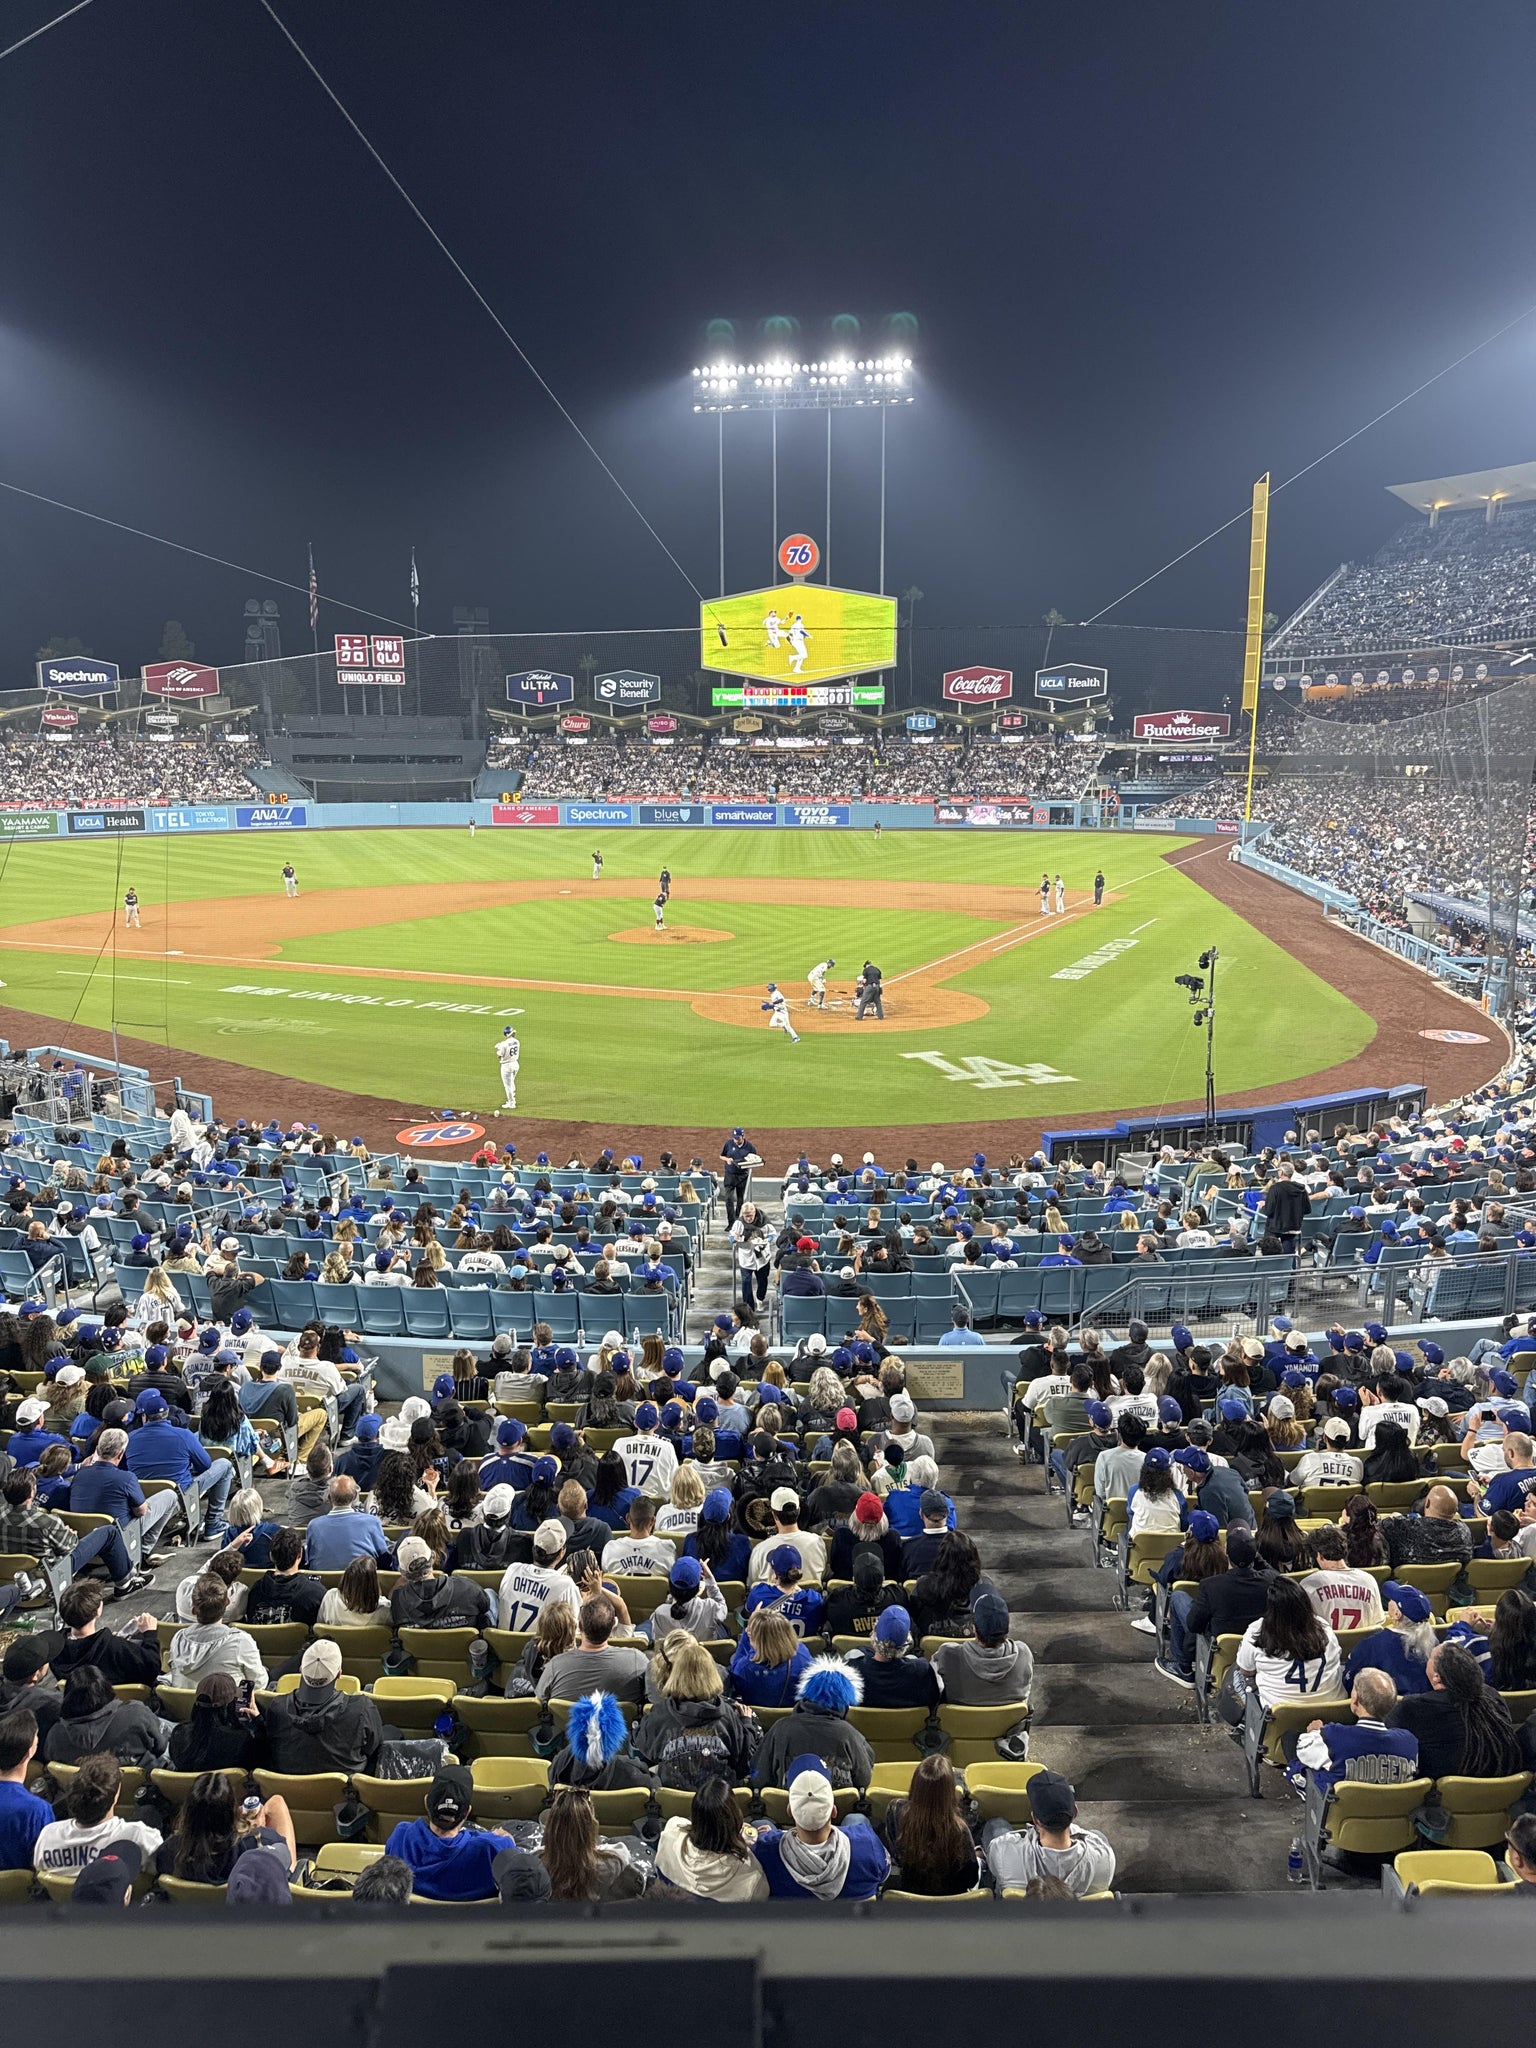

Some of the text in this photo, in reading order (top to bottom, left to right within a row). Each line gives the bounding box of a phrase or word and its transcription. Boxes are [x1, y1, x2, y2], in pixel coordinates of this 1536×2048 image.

[787, 544, 812, 565] 76
[376, 640, 398, 651] UNI
[376, 652, 400, 664] QLO
[49, 669, 107, 683] Spectrum
[341, 673, 402, 683] UNIQLO FIELD
[521, 681, 559, 690] ULTRA
[619, 679, 654, 690] Security
[949, 675, 1005, 695] Coca-Cola
[1040, 678, 1100, 688] UCLA Health
[620, 689, 649, 698] Benefit
[45, 713, 77, 721] Yakult
[910, 718, 933, 728] TEL
[562, 719, 589, 728] Churu
[1143, 723, 1220, 737] Budweiser
[251, 809, 278, 821] ANA
[570, 808, 624, 821] Spectrum
[655, 809, 679, 819] blue
[715, 811, 773, 821] smartwater
[794, 807, 829, 816] TOYO
[1036, 813, 1046, 821] 76
[78, 816, 139, 827] UCLA Health
[155, 812, 190, 828] TEL
[799, 815, 838, 825] TIRES
[1216, 822, 1239, 832] Yakult
[288, 990, 414, 1007] UNIQLO
[414, 1001, 525, 1016] FIELD
[897, 1050, 1082, 1089] LA
[407, 1122, 475, 1144] 76
[224, 1339, 249, 1350] OHTANI
[1284, 1363, 1319, 1373] YAMAMOTO
[285, 1368, 319, 1381] FREEMAN
[1050, 1384, 1070, 1395] BETT
[1383, 1412, 1411, 1424] OHTANI
[626, 1443, 662, 1458] OHTANI
[631, 1459, 654, 1487] 17
[1323, 1462, 1353, 1477] BETTS
[666, 1511, 699, 1530] DODGE
[620, 1555, 656, 1570] OHTANI
[513, 1576, 551, 1602] OHTANI
[1316, 1584, 1372, 1603] FRANCONA
[509, 1600, 540, 1632] 17
[1331, 1608, 1362, 1630] 17
[853, 1616, 879, 1633] RIVE
[1285, 1657, 1327, 1693] 47
[43, 1845, 99, 1869] ROBINS
